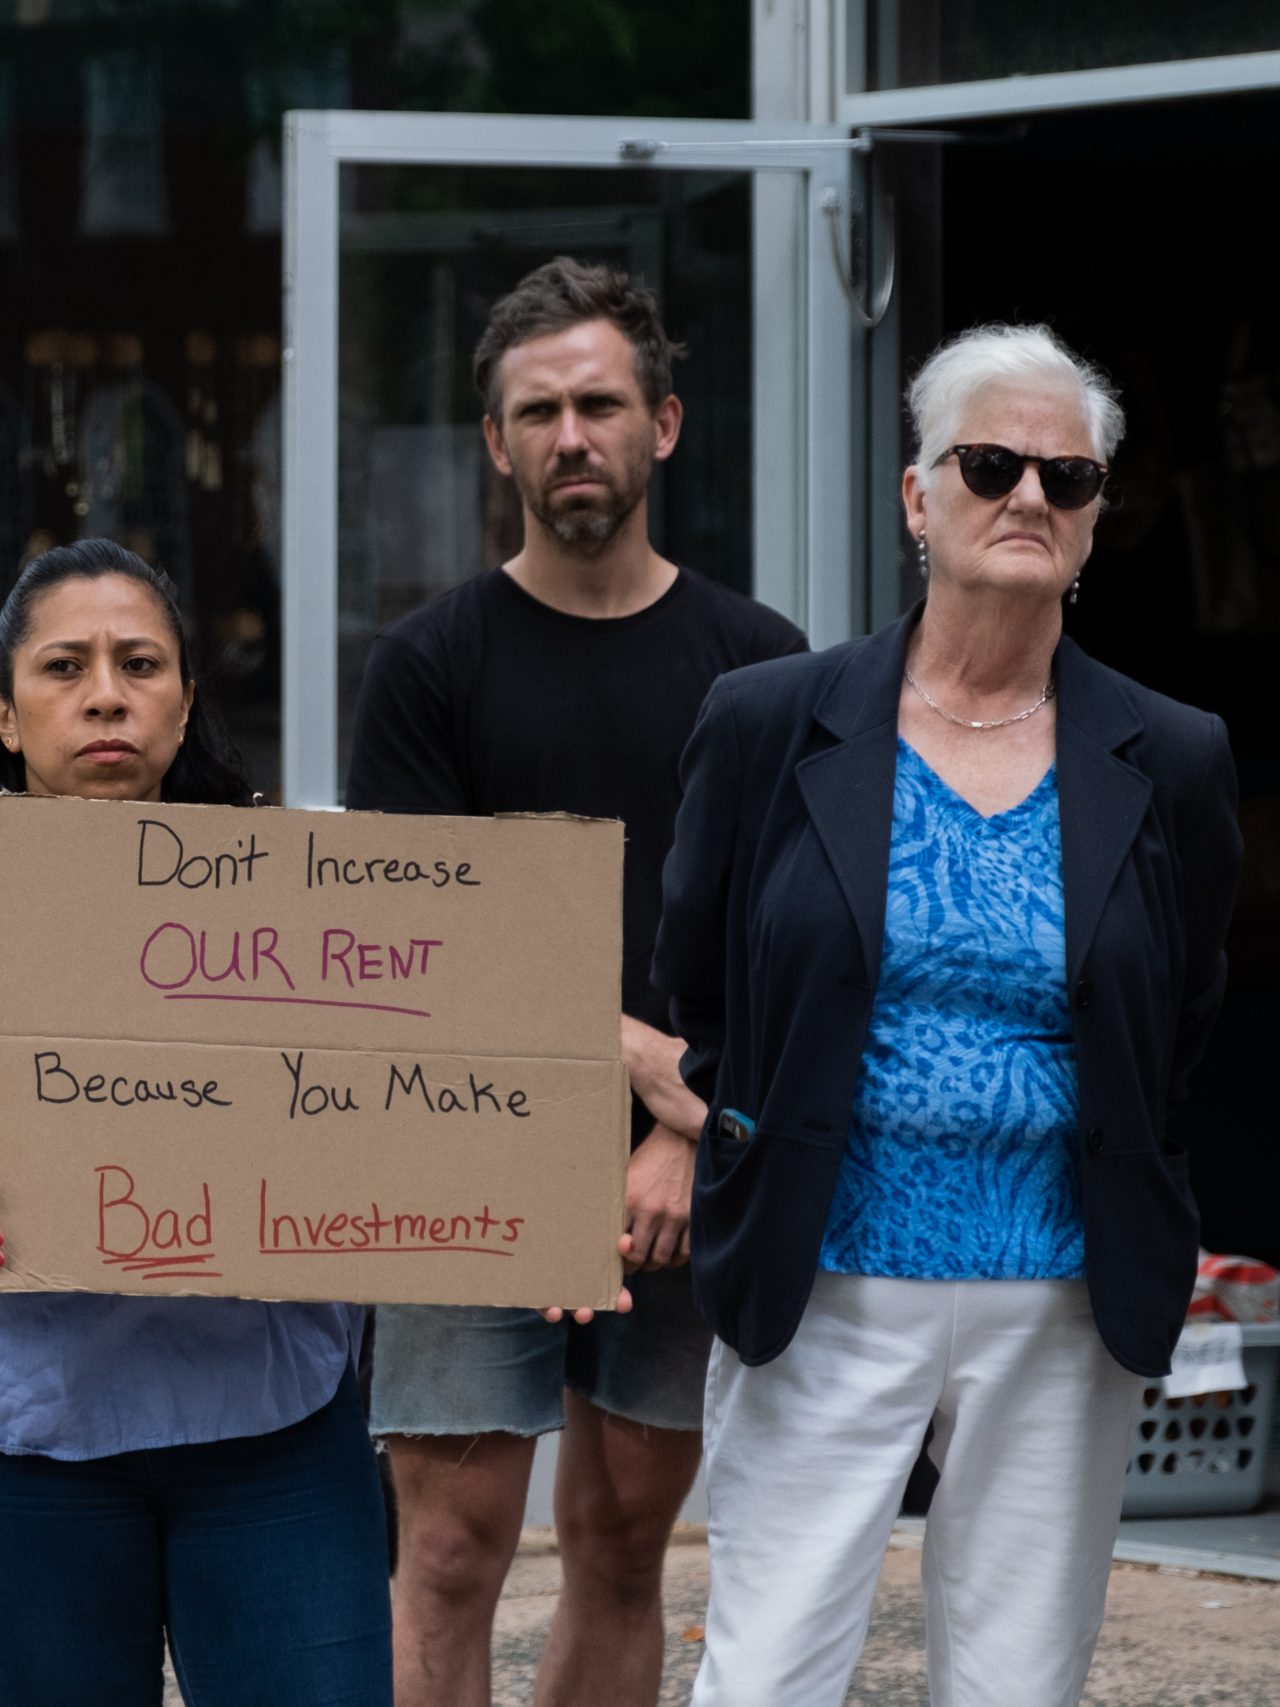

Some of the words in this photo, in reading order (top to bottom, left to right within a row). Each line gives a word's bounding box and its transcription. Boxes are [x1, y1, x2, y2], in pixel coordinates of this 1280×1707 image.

[137, 819, 270, 889] Don't
[307, 830, 481, 888] Increase
[139, 921, 296, 991] OUR
[321, 928, 444, 989] RENT
[34, 1051, 234, 1107] Because
[282, 1051, 360, 1119] You
[384, 1063, 532, 1118] Make
[95, 1165, 213, 1259] Bad
[259, 1179, 525, 1250] Investments
